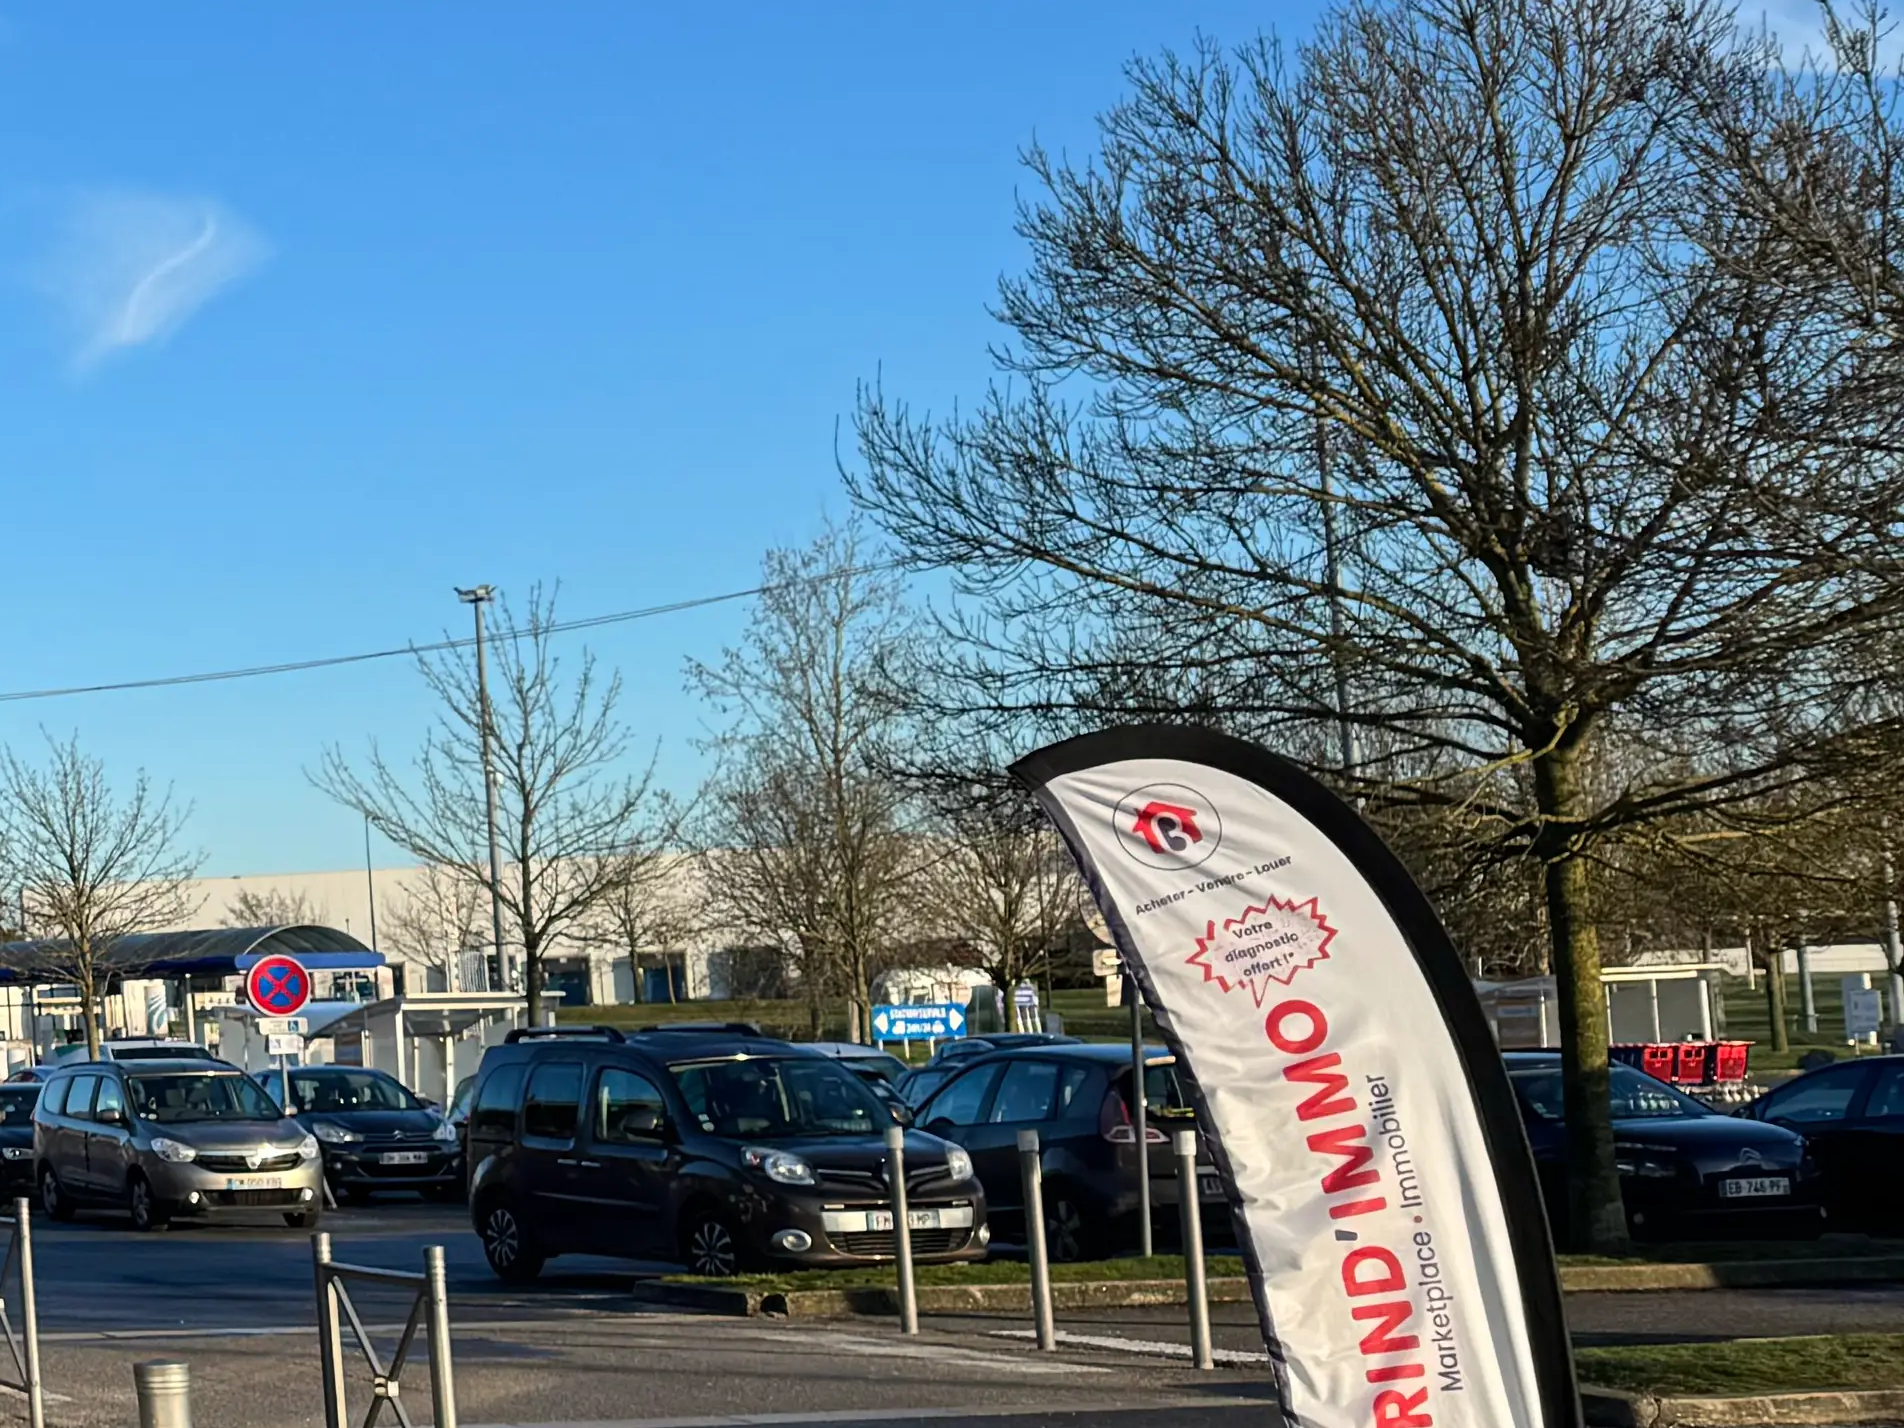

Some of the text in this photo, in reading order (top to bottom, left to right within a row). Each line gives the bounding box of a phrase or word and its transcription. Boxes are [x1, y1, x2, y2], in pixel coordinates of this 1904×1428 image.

[1135, 854, 1293, 916] Acheter Vendre Louer
[1231, 920, 1274, 941] Votre
[1224, 931, 1300, 964] diagnostic
[1242, 956, 1282, 978] offert
[1364, 1073, 1464, 1392] Marketplace Immobilier
